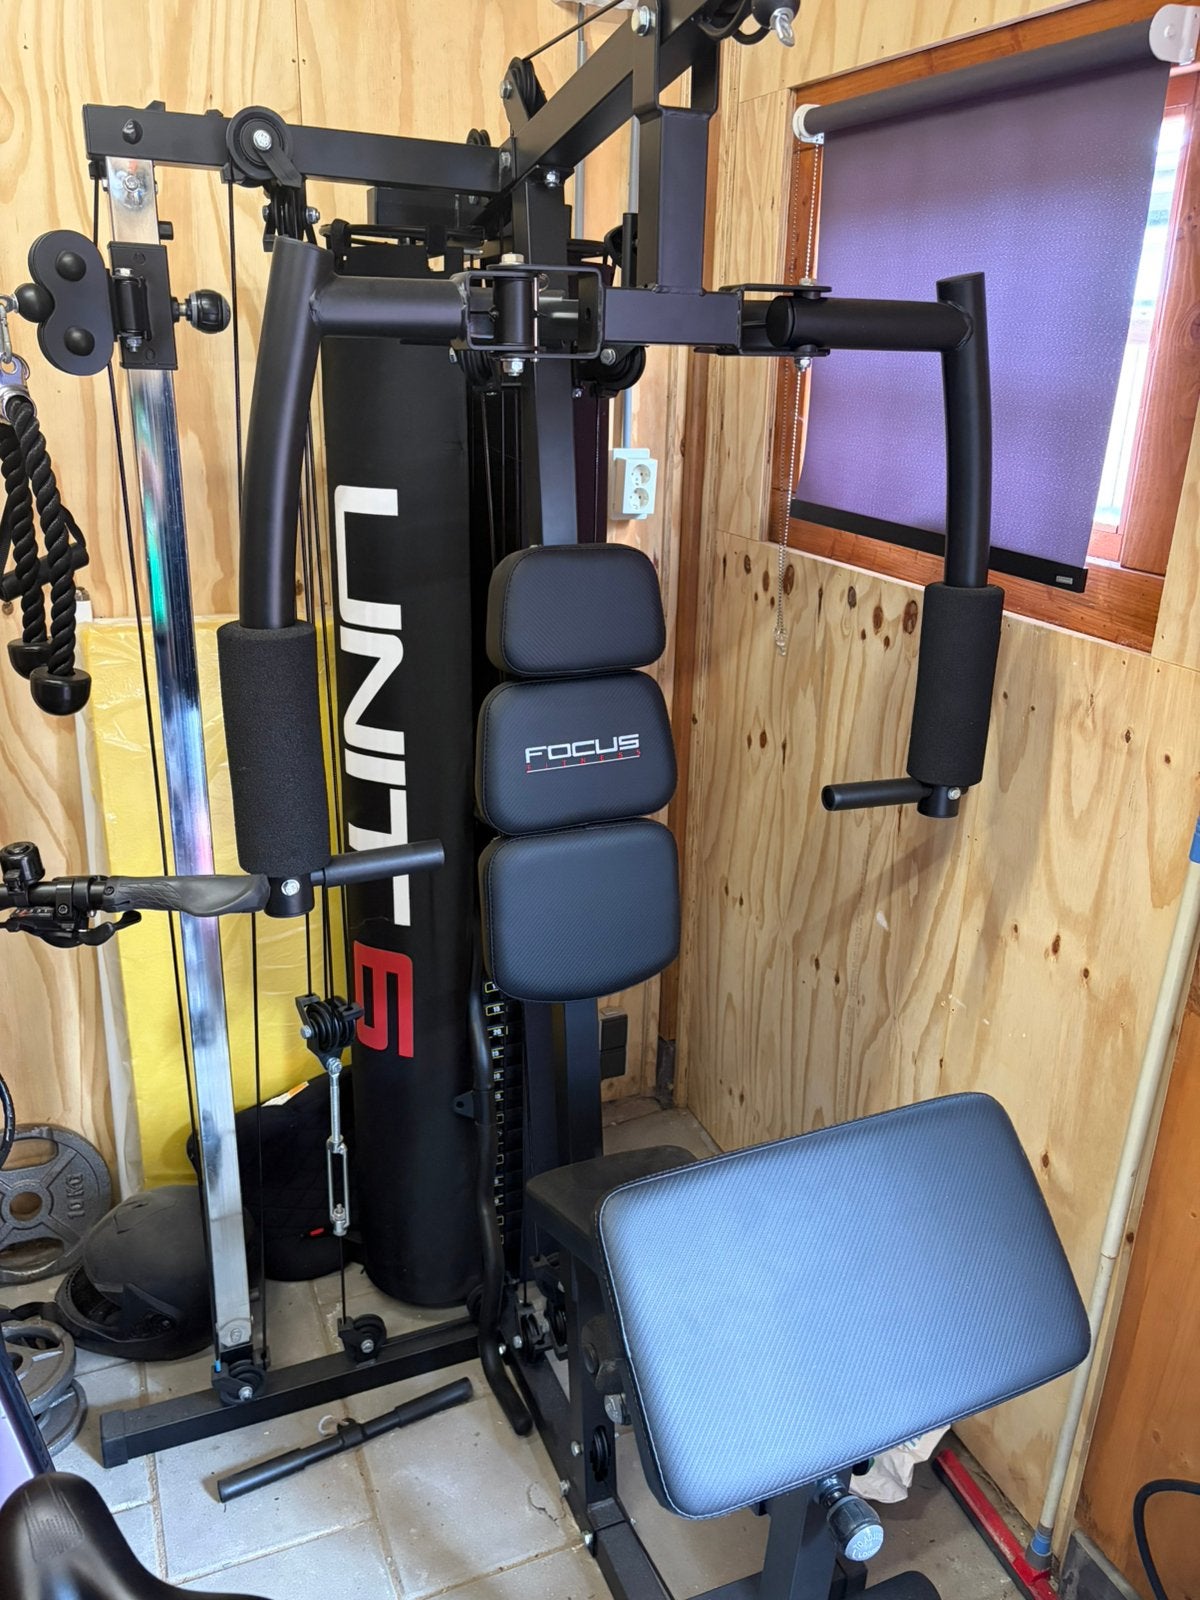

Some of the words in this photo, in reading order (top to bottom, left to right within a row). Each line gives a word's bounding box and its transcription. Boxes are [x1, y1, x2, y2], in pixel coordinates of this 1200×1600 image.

[334, 485, 410, 927] UNIT
[525, 733, 640, 764] FOCUS
[353, 940, 414, 1058] 6
[67, 1202, 86, 1220] 10
